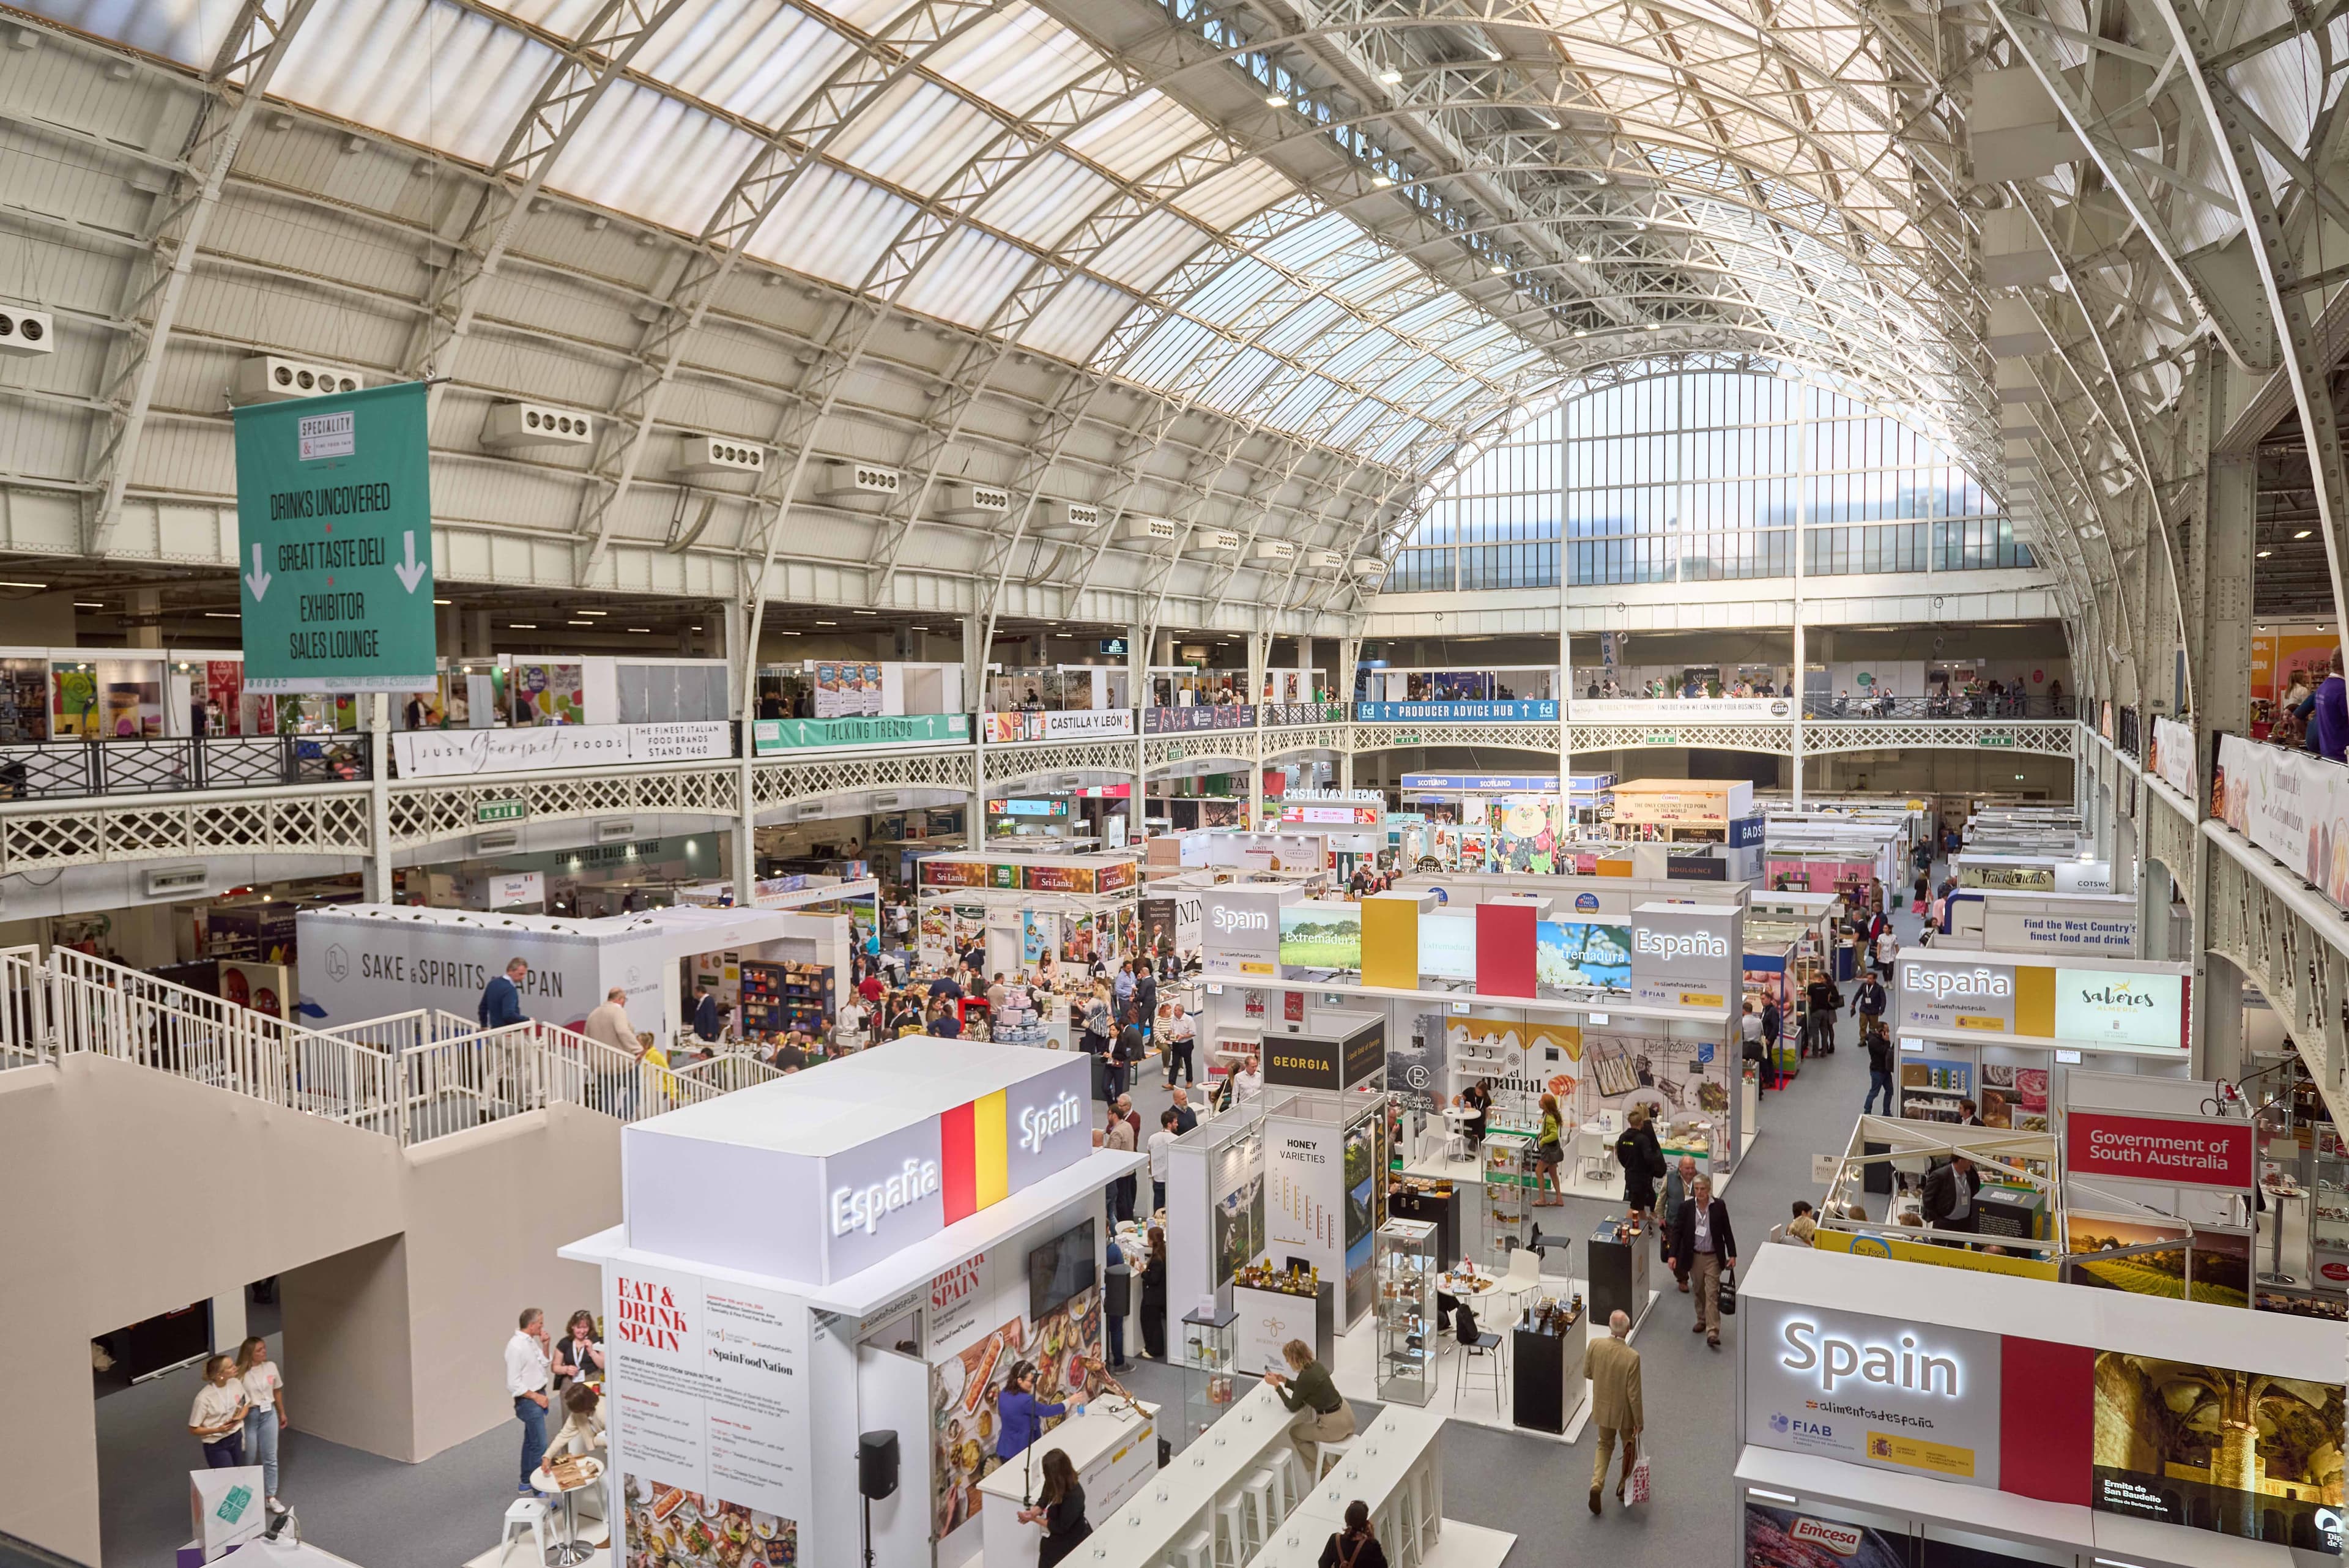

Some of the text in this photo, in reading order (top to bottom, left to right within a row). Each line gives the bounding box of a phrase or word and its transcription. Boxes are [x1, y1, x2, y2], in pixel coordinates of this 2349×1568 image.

[302, 417, 351, 436] SPECIALITY
[271, 482, 390, 521] DRINKS UNCOVERED
[278, 537, 385, 571] GREAT TASTE DELI
[300, 592, 365, 622] EXHIBITOR
[290, 630, 379, 660] SALES LOUNGE
[1362, 704, 1375, 715] fd
[1399, 704, 1513, 717] PRODUCER ADVICE HUB
[1540, 703, 1553, 715] fd
[655, 726, 684, 734] FINEST
[686, 724, 719, 734] ITALIAN
[1051, 712, 1123, 729] CASTILLA Y LEÓN
[825, 720, 913, 741] TALKING TRENDS
[648, 735, 708, 745] FOOD BRANDS
[422, 730, 623, 775] JUST Gourmet FOODS
[648, 745, 708, 757] STAND 1460
[555, 849, 600, 866] EXHIBITOR
[603, 845, 627, 860] SALES
[628, 841, 659, 856] LOUNGE
[1417, 864, 1441, 873] taste
[948, 873, 967, 882] Lanka
[1041, 878, 1052, 886] Sri
[1113, 877, 1126, 885] Lanka
[505, 882, 522, 891] Taste
[505, 890, 526, 898] France
[1212, 907, 1269, 934] Spain
[2024, 919, 2137, 934] Find the West Country's
[1285, 932, 1356, 946] Extremadura
[1636, 931, 1726, 960] España
[2030, 931, 2130, 945] finest food and drink
[1423, 942, 1471, 952] Extremadura
[362, 953, 404, 981] SAKE
[410, 968, 417, 983] &
[420, 959, 485, 990] SPIRITS
[1659, 981, 1707, 990] alimentosdespaña
[1906, 965, 2009, 998] España
[2082, 987, 2154, 1008] sabores
[1934, 1003, 1987, 1013] alimentosdespaña
[2097, 1005, 2138, 1014] ALMERÍA
[1273, 1057, 1329, 1071] GEORGIA
[1020, 1091, 1081, 1154] Spain
[1287, 1139, 1317, 1150] HONEY
[2090, 1129, 2230, 1154] Government of
[1280, 1150, 1326, 1164] VARIETIES
[2090, 1145, 2228, 1170] South Australia
[1377, 1122, 1386, 1230] GEORGIA
[832, 1158, 939, 1236] España
[1855, 1245, 1885, 1256] The Food
[1909, 1256, 1940, 1266] Innovate
[618, 1277, 676, 1307] EAT &
[930, 1269, 980, 1312] SPAIN
[619, 1298, 688, 1333] DRINK
[619, 1321, 680, 1353] SPAIN
[708, 1347, 793, 1376] #SpainFoodNation
[1783, 1321, 1958, 1395] Spain
[656, 1362, 669, 1371] FOOD
[669, 1366, 683, 1375] FROM
[684, 1369, 698, 1378] SPAIN
[1820, 1402, 1934, 1429] alimentosdespaña
[1793, 1420, 1832, 1436] FIAB
[2104, 1479, 2147, 1493] Ermita de
[2104, 1487, 2162, 1504] San Baudelio
[1798, 1522, 1857, 1545] Emcesa
